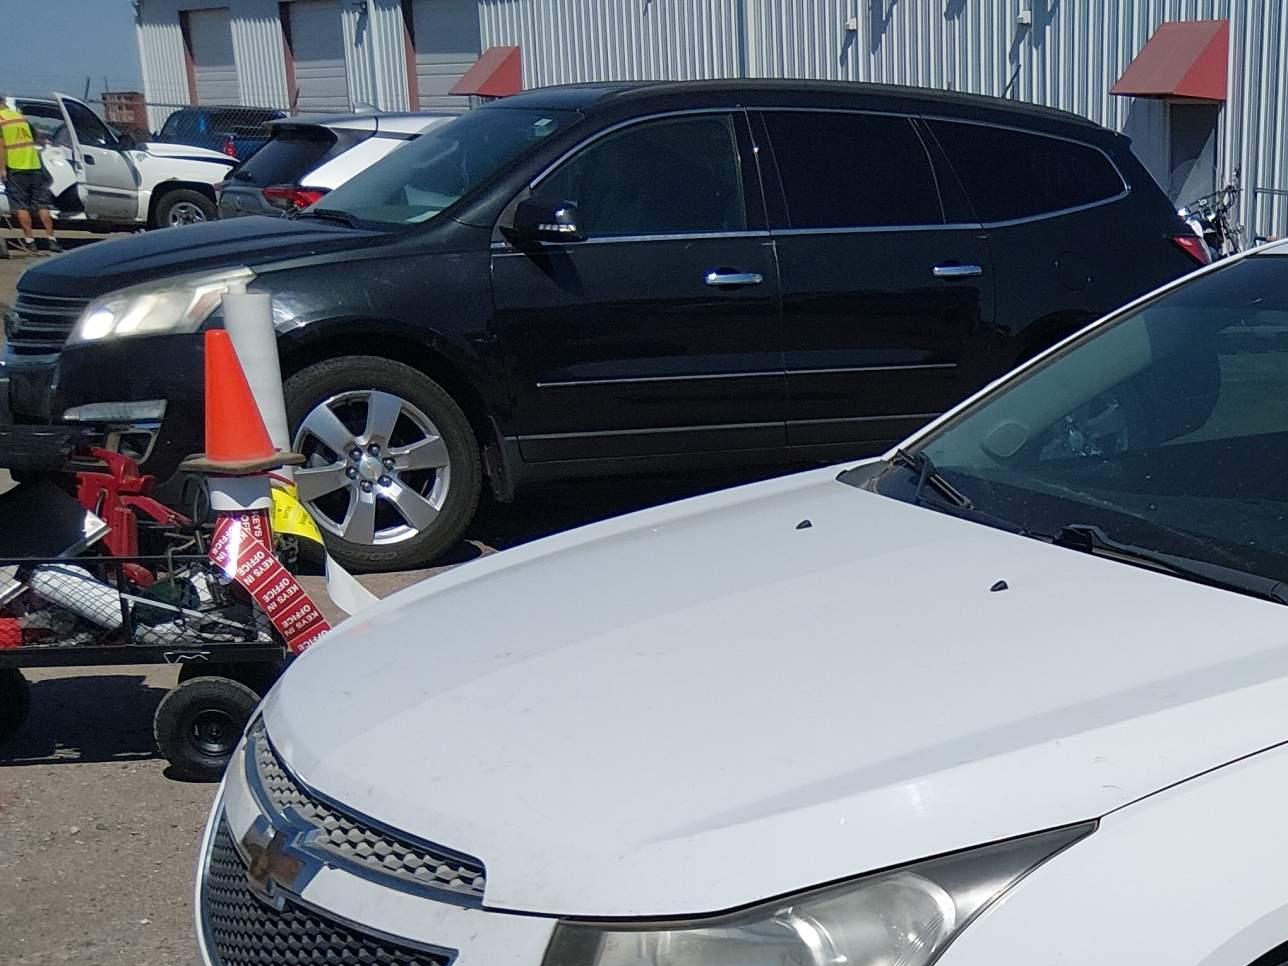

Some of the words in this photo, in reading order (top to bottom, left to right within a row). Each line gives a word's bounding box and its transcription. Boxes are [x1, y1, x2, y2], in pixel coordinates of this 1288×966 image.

[216, 551, 228, 563] IN
[237, 551, 265, 576] OFFICE
[253, 556, 275, 577] KEYS
[243, 574, 256, 586] IN
[262, 577, 290, 603] OFFICE
[277, 584, 299, 604] KEYS
[266, 602, 278, 613] IN
[281, 604, 311, 628] OFFICE
[296, 610, 319, 630] KEYS
[284, 627, 296, 637] IN
